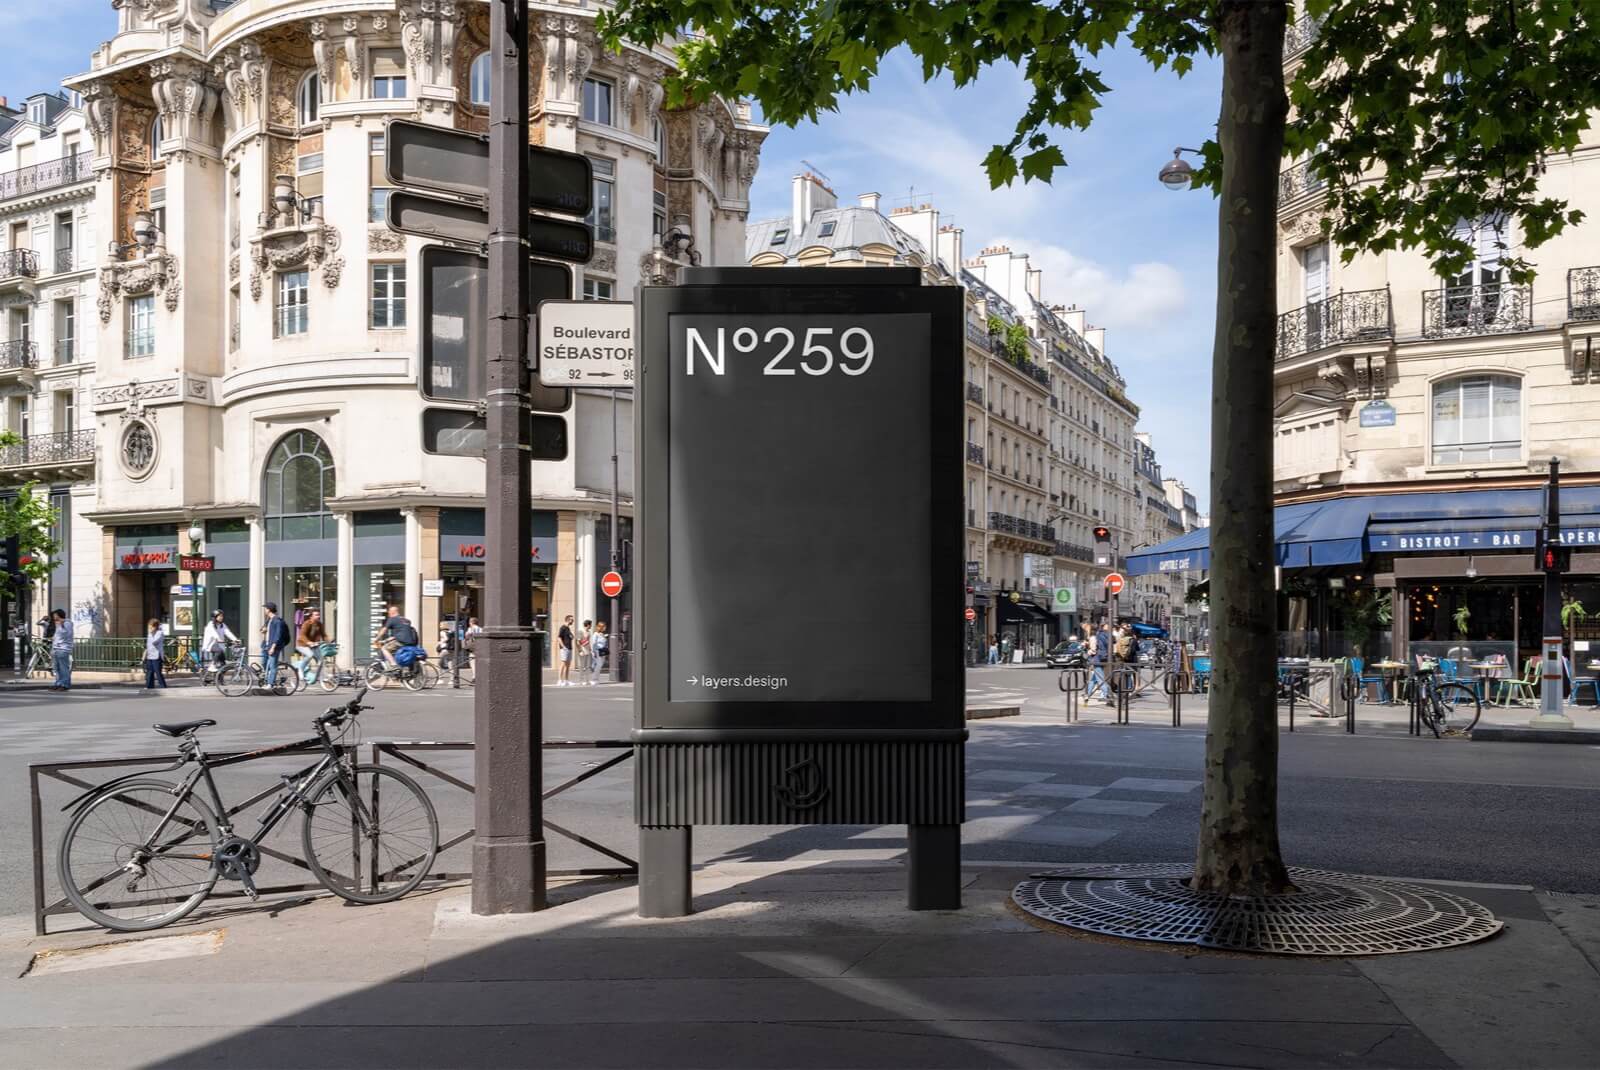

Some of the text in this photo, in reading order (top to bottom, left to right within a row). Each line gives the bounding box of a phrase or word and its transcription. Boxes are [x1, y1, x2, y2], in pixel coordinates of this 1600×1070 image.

[553, 326, 631, 339] Boulevard
[568, 369, 581, 379] 92
[1400, 536, 1460, 548] BISTROT
[1492, 534, 1521, 545] BAR
[702, 675, 788, 689] layers.design
